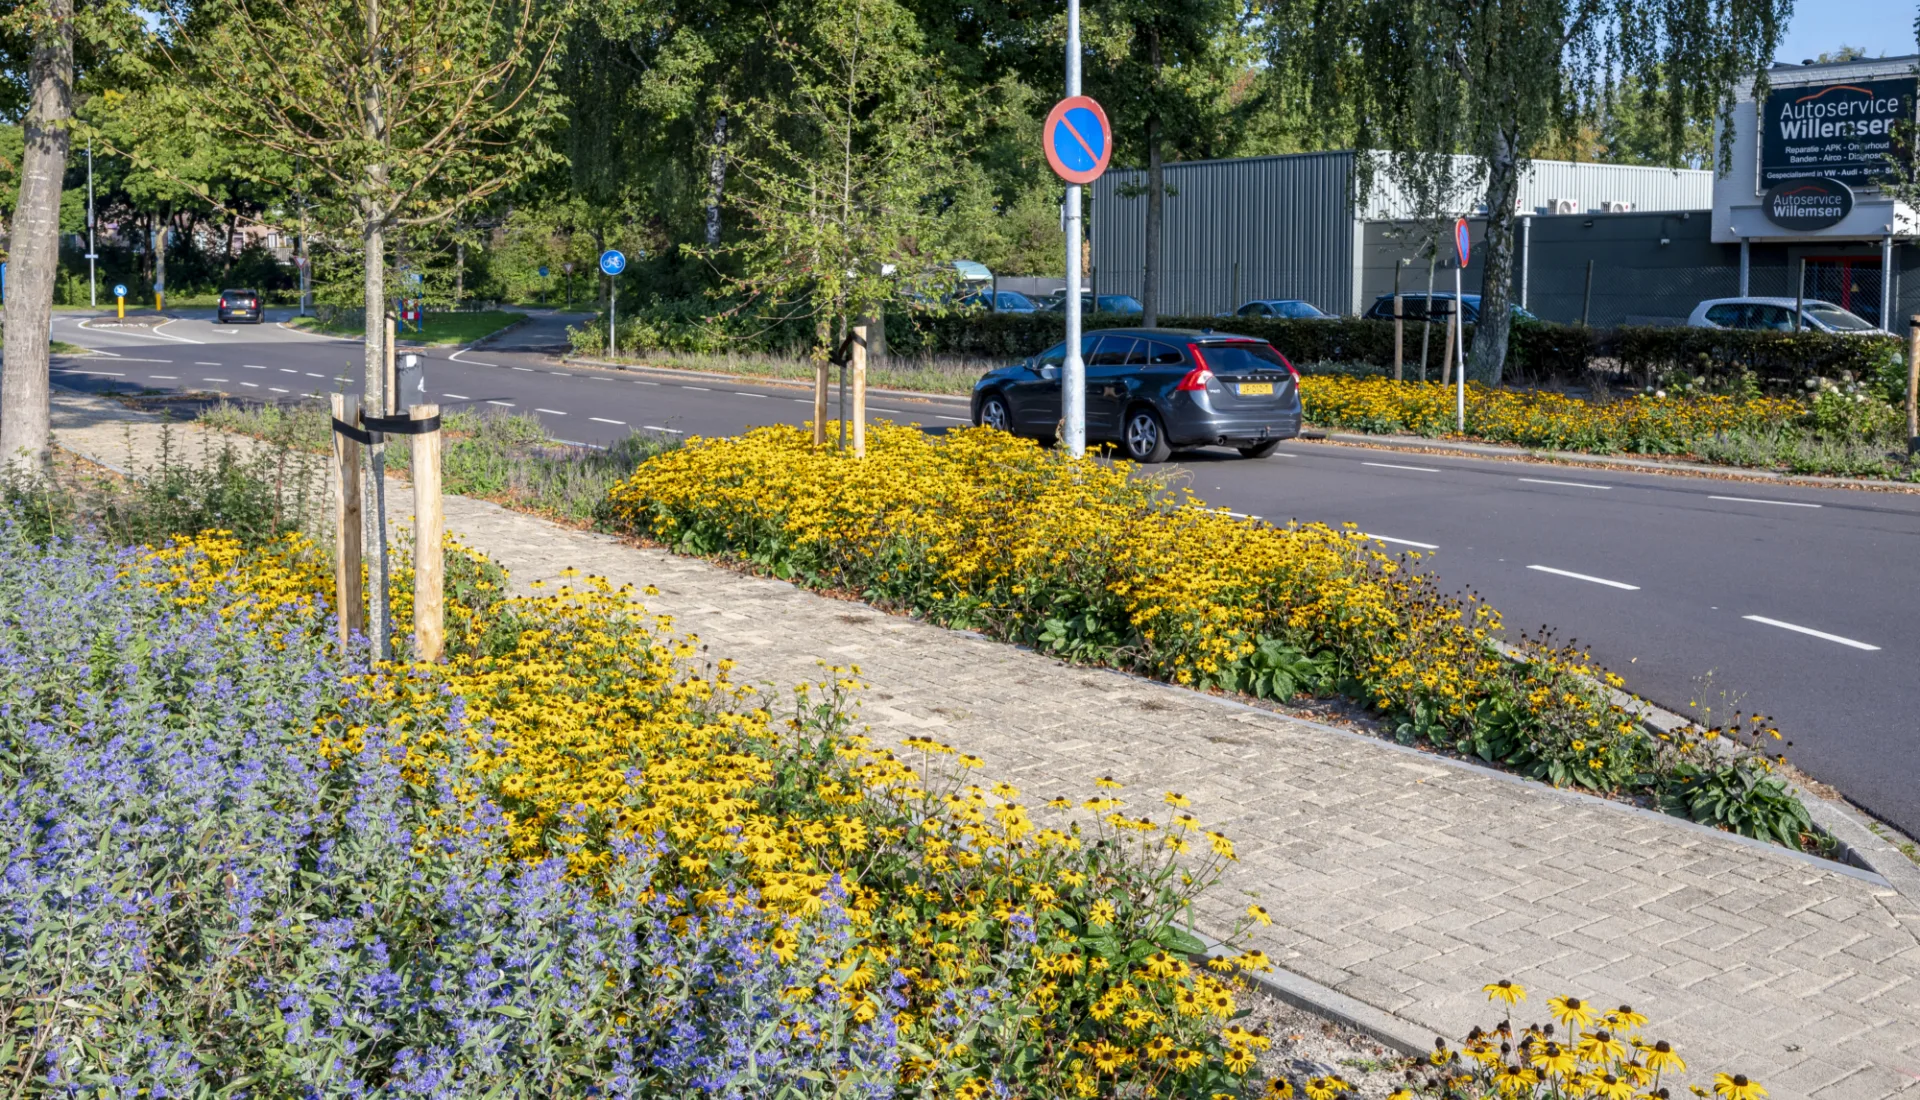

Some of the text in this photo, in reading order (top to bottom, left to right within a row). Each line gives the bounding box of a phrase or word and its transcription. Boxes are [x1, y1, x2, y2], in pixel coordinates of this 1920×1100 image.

[1780, 96, 1899, 120] Autoservice
[1785, 146, 1819, 155] Reparatie
[1825, 144, 1842, 152] APK
[1848, 141, 1890, 151] Onrhoud
[1790, 155, 1817, 163] Banden
[1823, 154, 1842, 162] Airco
[1824, 169, 1836, 177] VW
[1841, 168, 1858, 176] Audi
[1773, 194, 1842, 205] Autoservice
[1773, 205, 1841, 217] Willemsen
